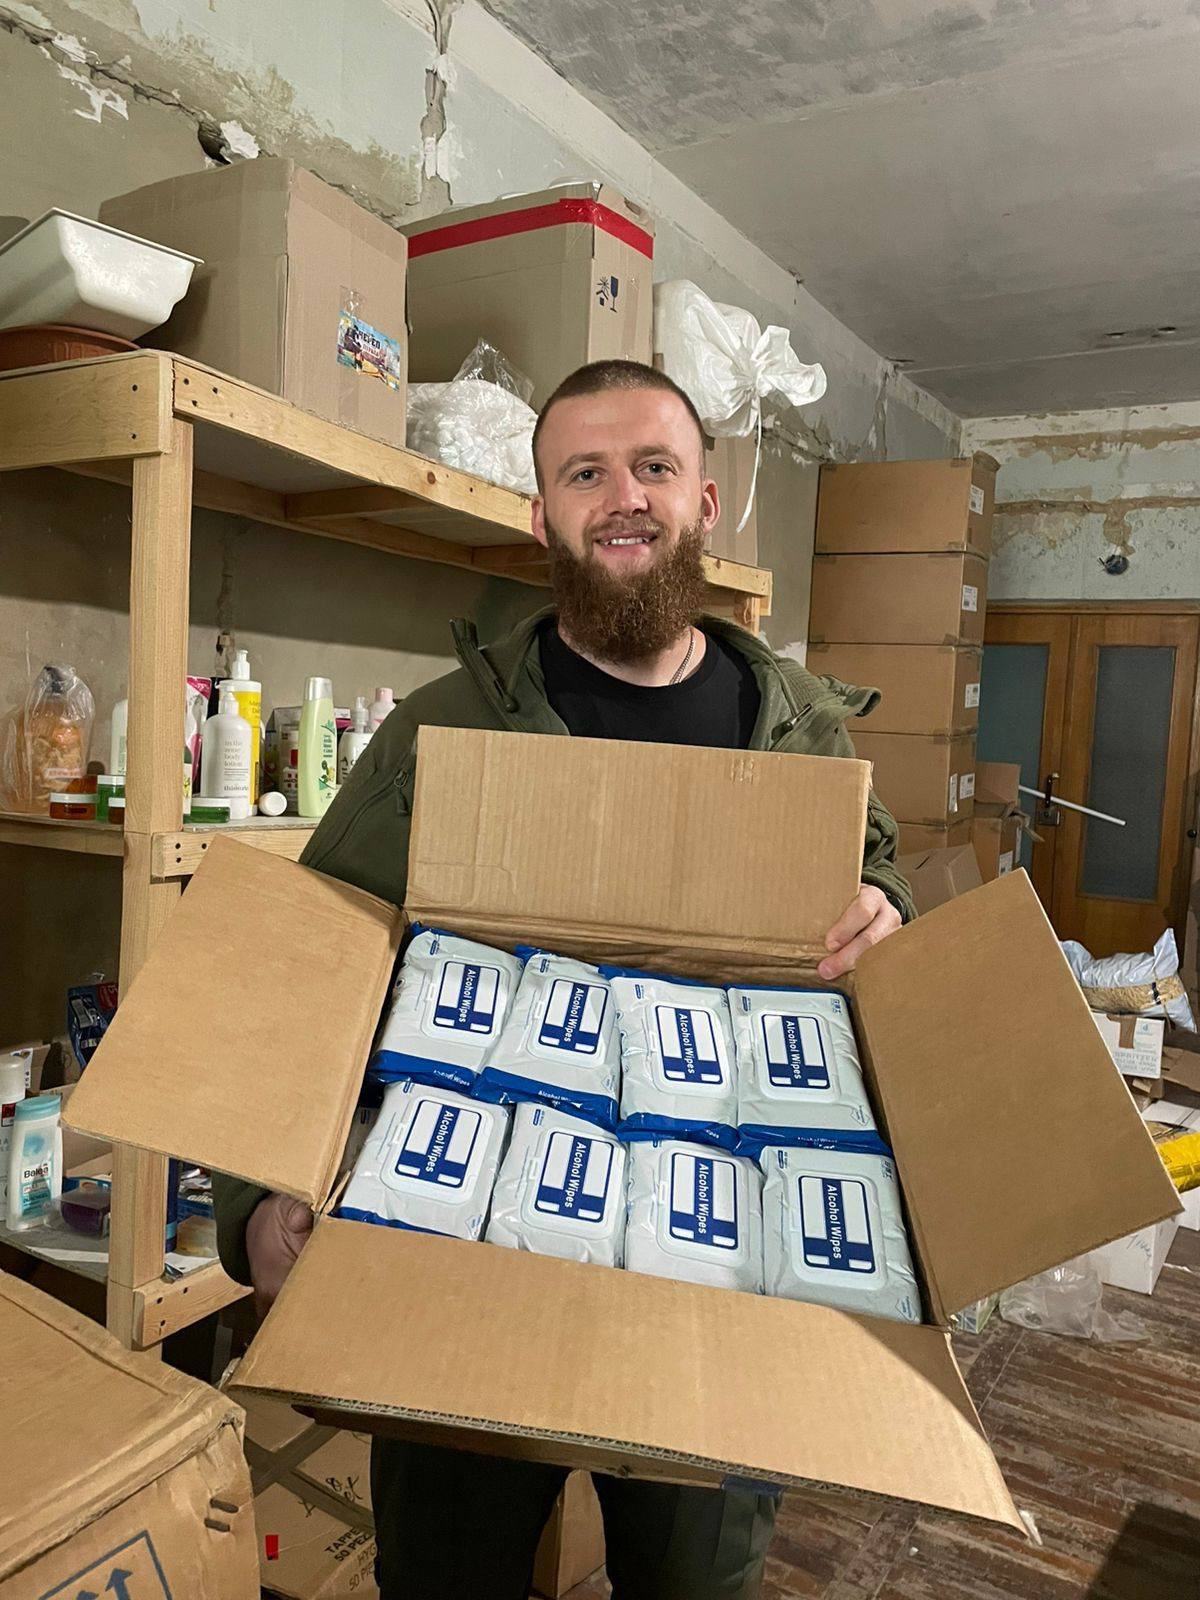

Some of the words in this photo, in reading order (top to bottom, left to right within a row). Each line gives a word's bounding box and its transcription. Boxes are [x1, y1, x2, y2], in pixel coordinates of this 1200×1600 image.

[463, 968, 476, 999] Alcohol
[458, 999, 472, 1022] Wipes
[570, 987, 584, 1018] Alcohol
[563, 1018, 578, 1042] Wipes
[678, 1013, 692, 1046] Alcohol
[785, 1020, 799, 1052] Alcohol
[684, 1047, 695, 1074] Wipes
[790, 1053, 802, 1079] Wipes
[435, 1110, 454, 1145] Alcohol
[23, 1166, 50, 1179] Balea
[425, 1145, 444, 1172] Wipes
[570, 1141, 587, 1178] Alcohol
[564, 1179, 580, 1208] Wipes
[698, 1163, 709, 1202] Alcohol
[695, 1203, 709, 1234] Wipes
[826, 1184, 840, 1224] Alcohol
[830, 1226, 842, 1259] Wipes
